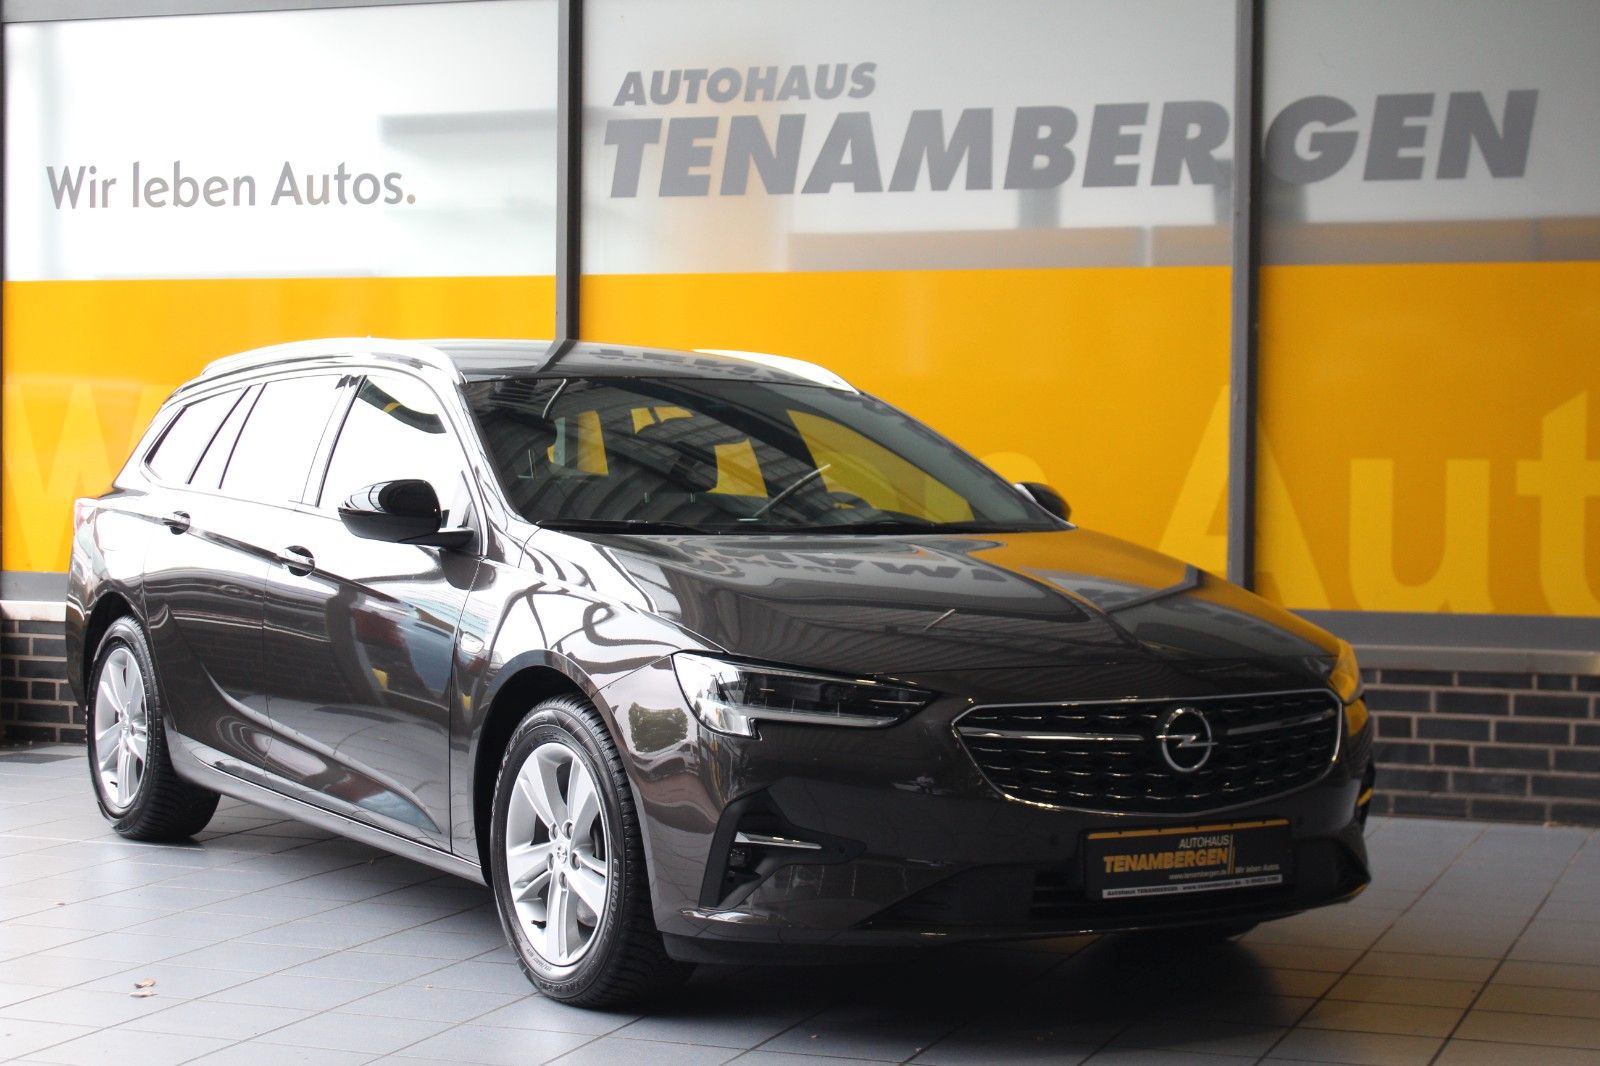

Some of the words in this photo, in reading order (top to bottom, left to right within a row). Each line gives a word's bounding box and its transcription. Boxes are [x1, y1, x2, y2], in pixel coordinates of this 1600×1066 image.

[613, 62, 877, 107] AUTOHAUS
[604, 89, 1539, 198] TENAMBERGEN
[46, 165, 117, 209] Wir
[132, 160, 256, 208] leben
[270, 161, 416, 206] Autos.
[1103, 847, 1228, 873] TENAMBERGEN
[1179, 834, 1229, 848] AUTOHAUS
